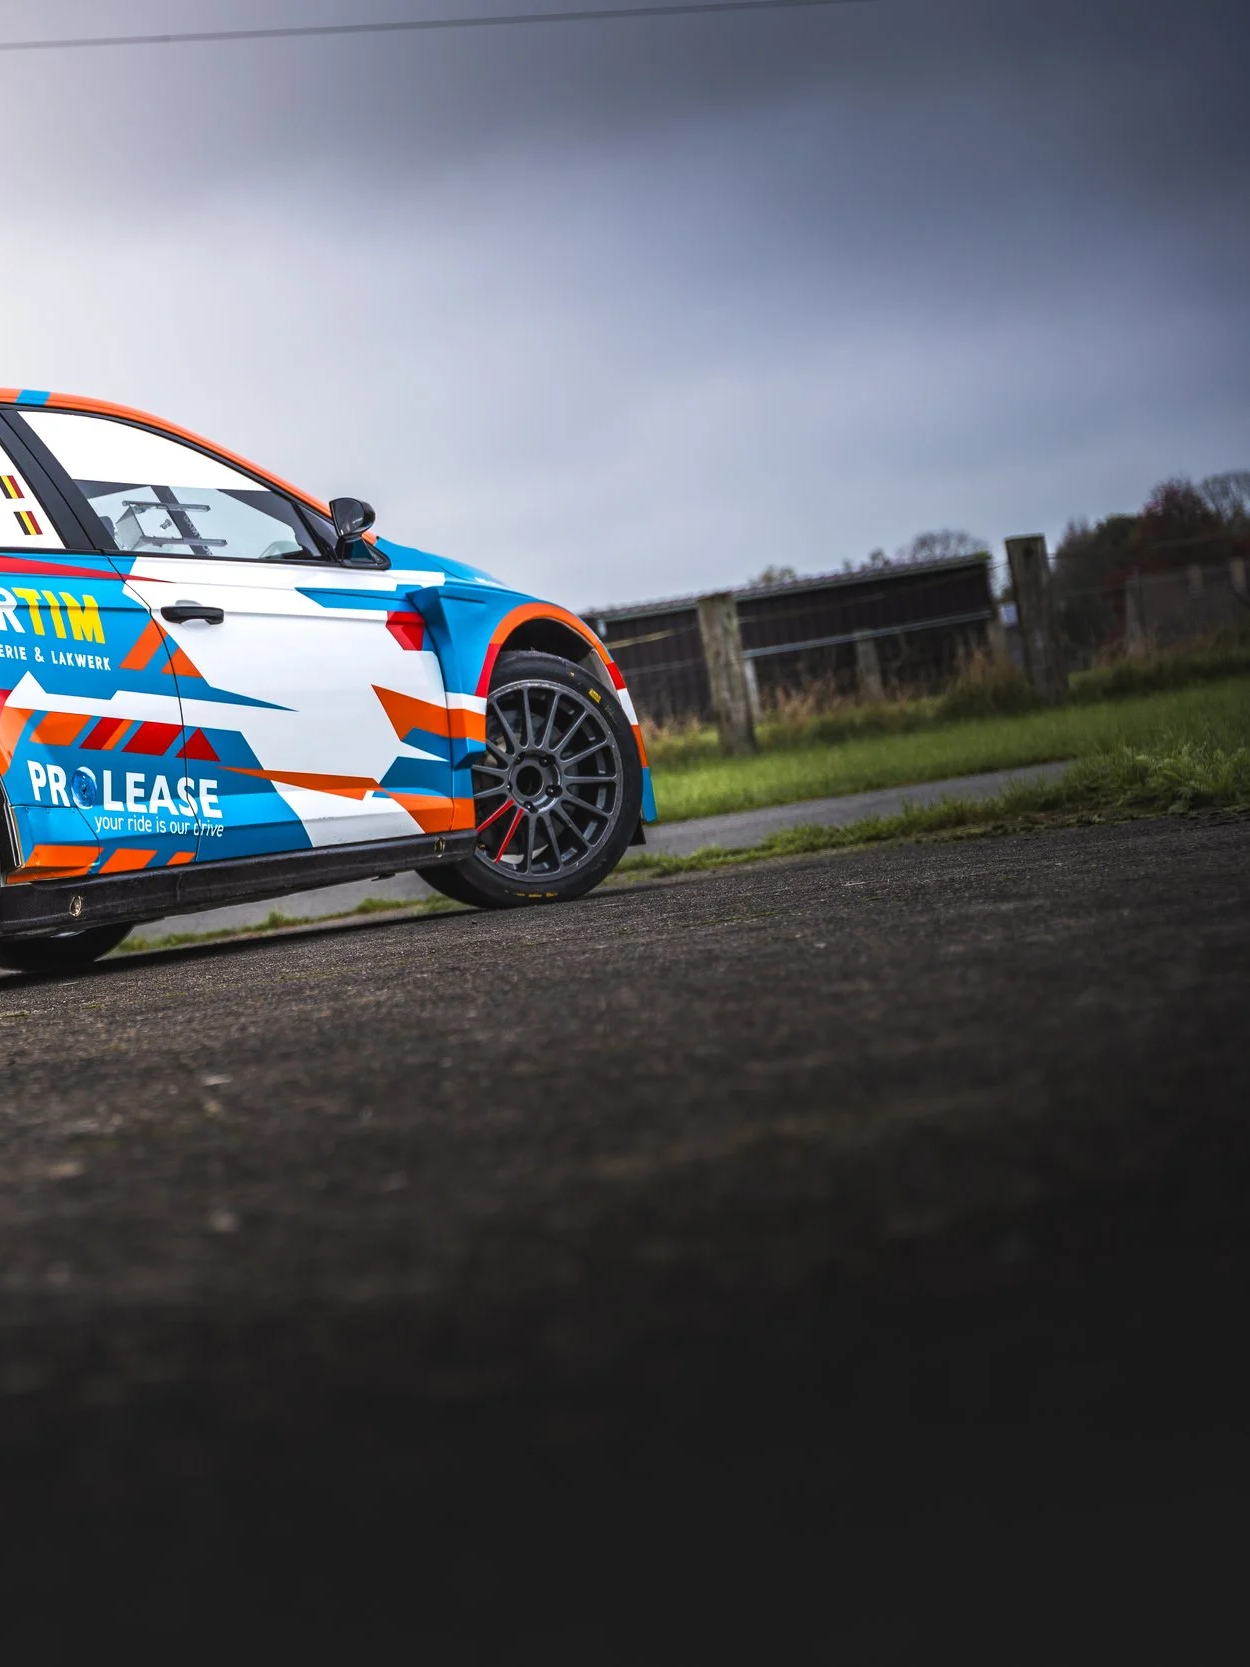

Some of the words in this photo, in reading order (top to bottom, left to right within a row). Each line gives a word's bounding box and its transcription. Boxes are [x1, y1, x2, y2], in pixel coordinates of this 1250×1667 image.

[34, 646, 45, 663] &
[51, 650, 111, 672] LAKWERK
[94, 815, 125, 834] your
[127, 815, 153, 832] ride
[155, 816, 167, 833] is
[169, 822, 191, 835] our
[193, 819, 225, 838] drive
